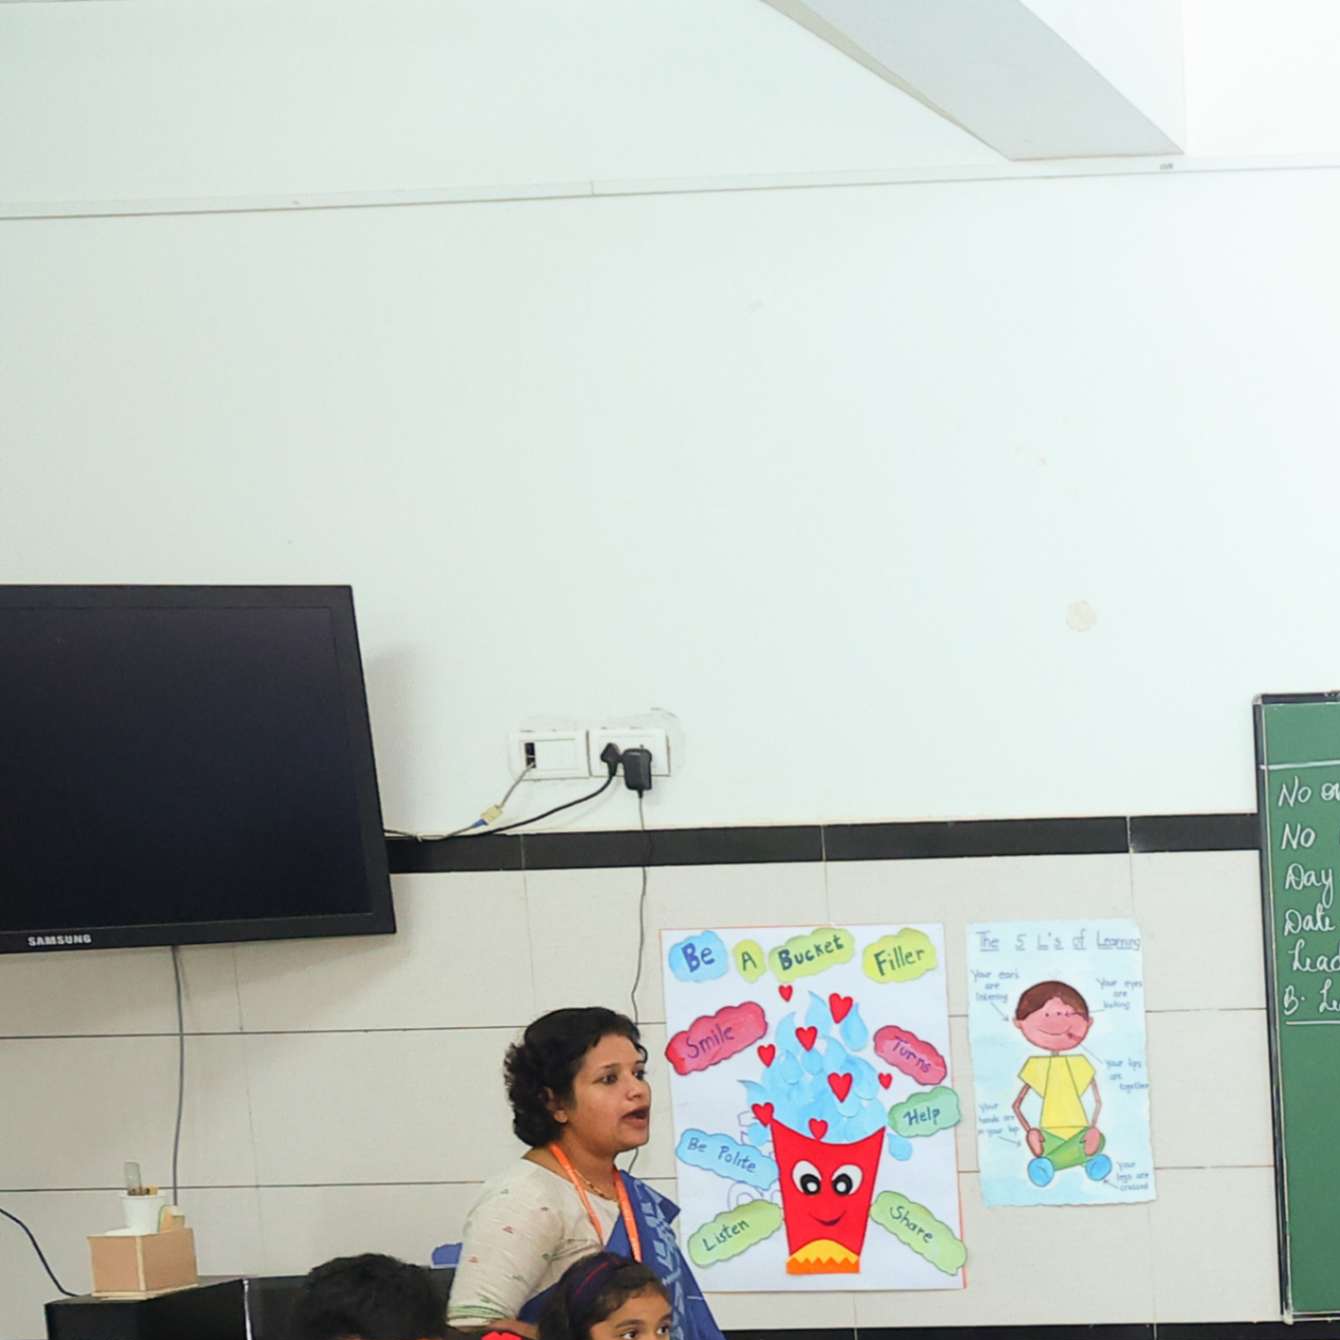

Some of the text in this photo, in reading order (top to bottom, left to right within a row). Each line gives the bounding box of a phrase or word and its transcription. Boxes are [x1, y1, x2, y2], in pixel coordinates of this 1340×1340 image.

[1278, 776, 1312, 808] No
[1282, 823, 1316, 850] No
[1284, 861, 1335, 906] Day
[1284, 905, 1336, 936] Date
[27, 933, 93, 947] SAMSUNG
[682, 934, 926, 977] Be A Bucket Filler
[975, 930, 1001, 950] The
[1072, 928, 1088, 950] of
[1096, 930, 1143, 951] Learning
[686, 1023, 735, 1059] Smile
[891, 1034, 933, 1075] Turns
[902, 1104, 942, 1127] Help
[687, 1136, 757, 1173] Be Polite
[702, 1218, 750, 1252] Listen
[889, 1204, 934, 1244] Share
